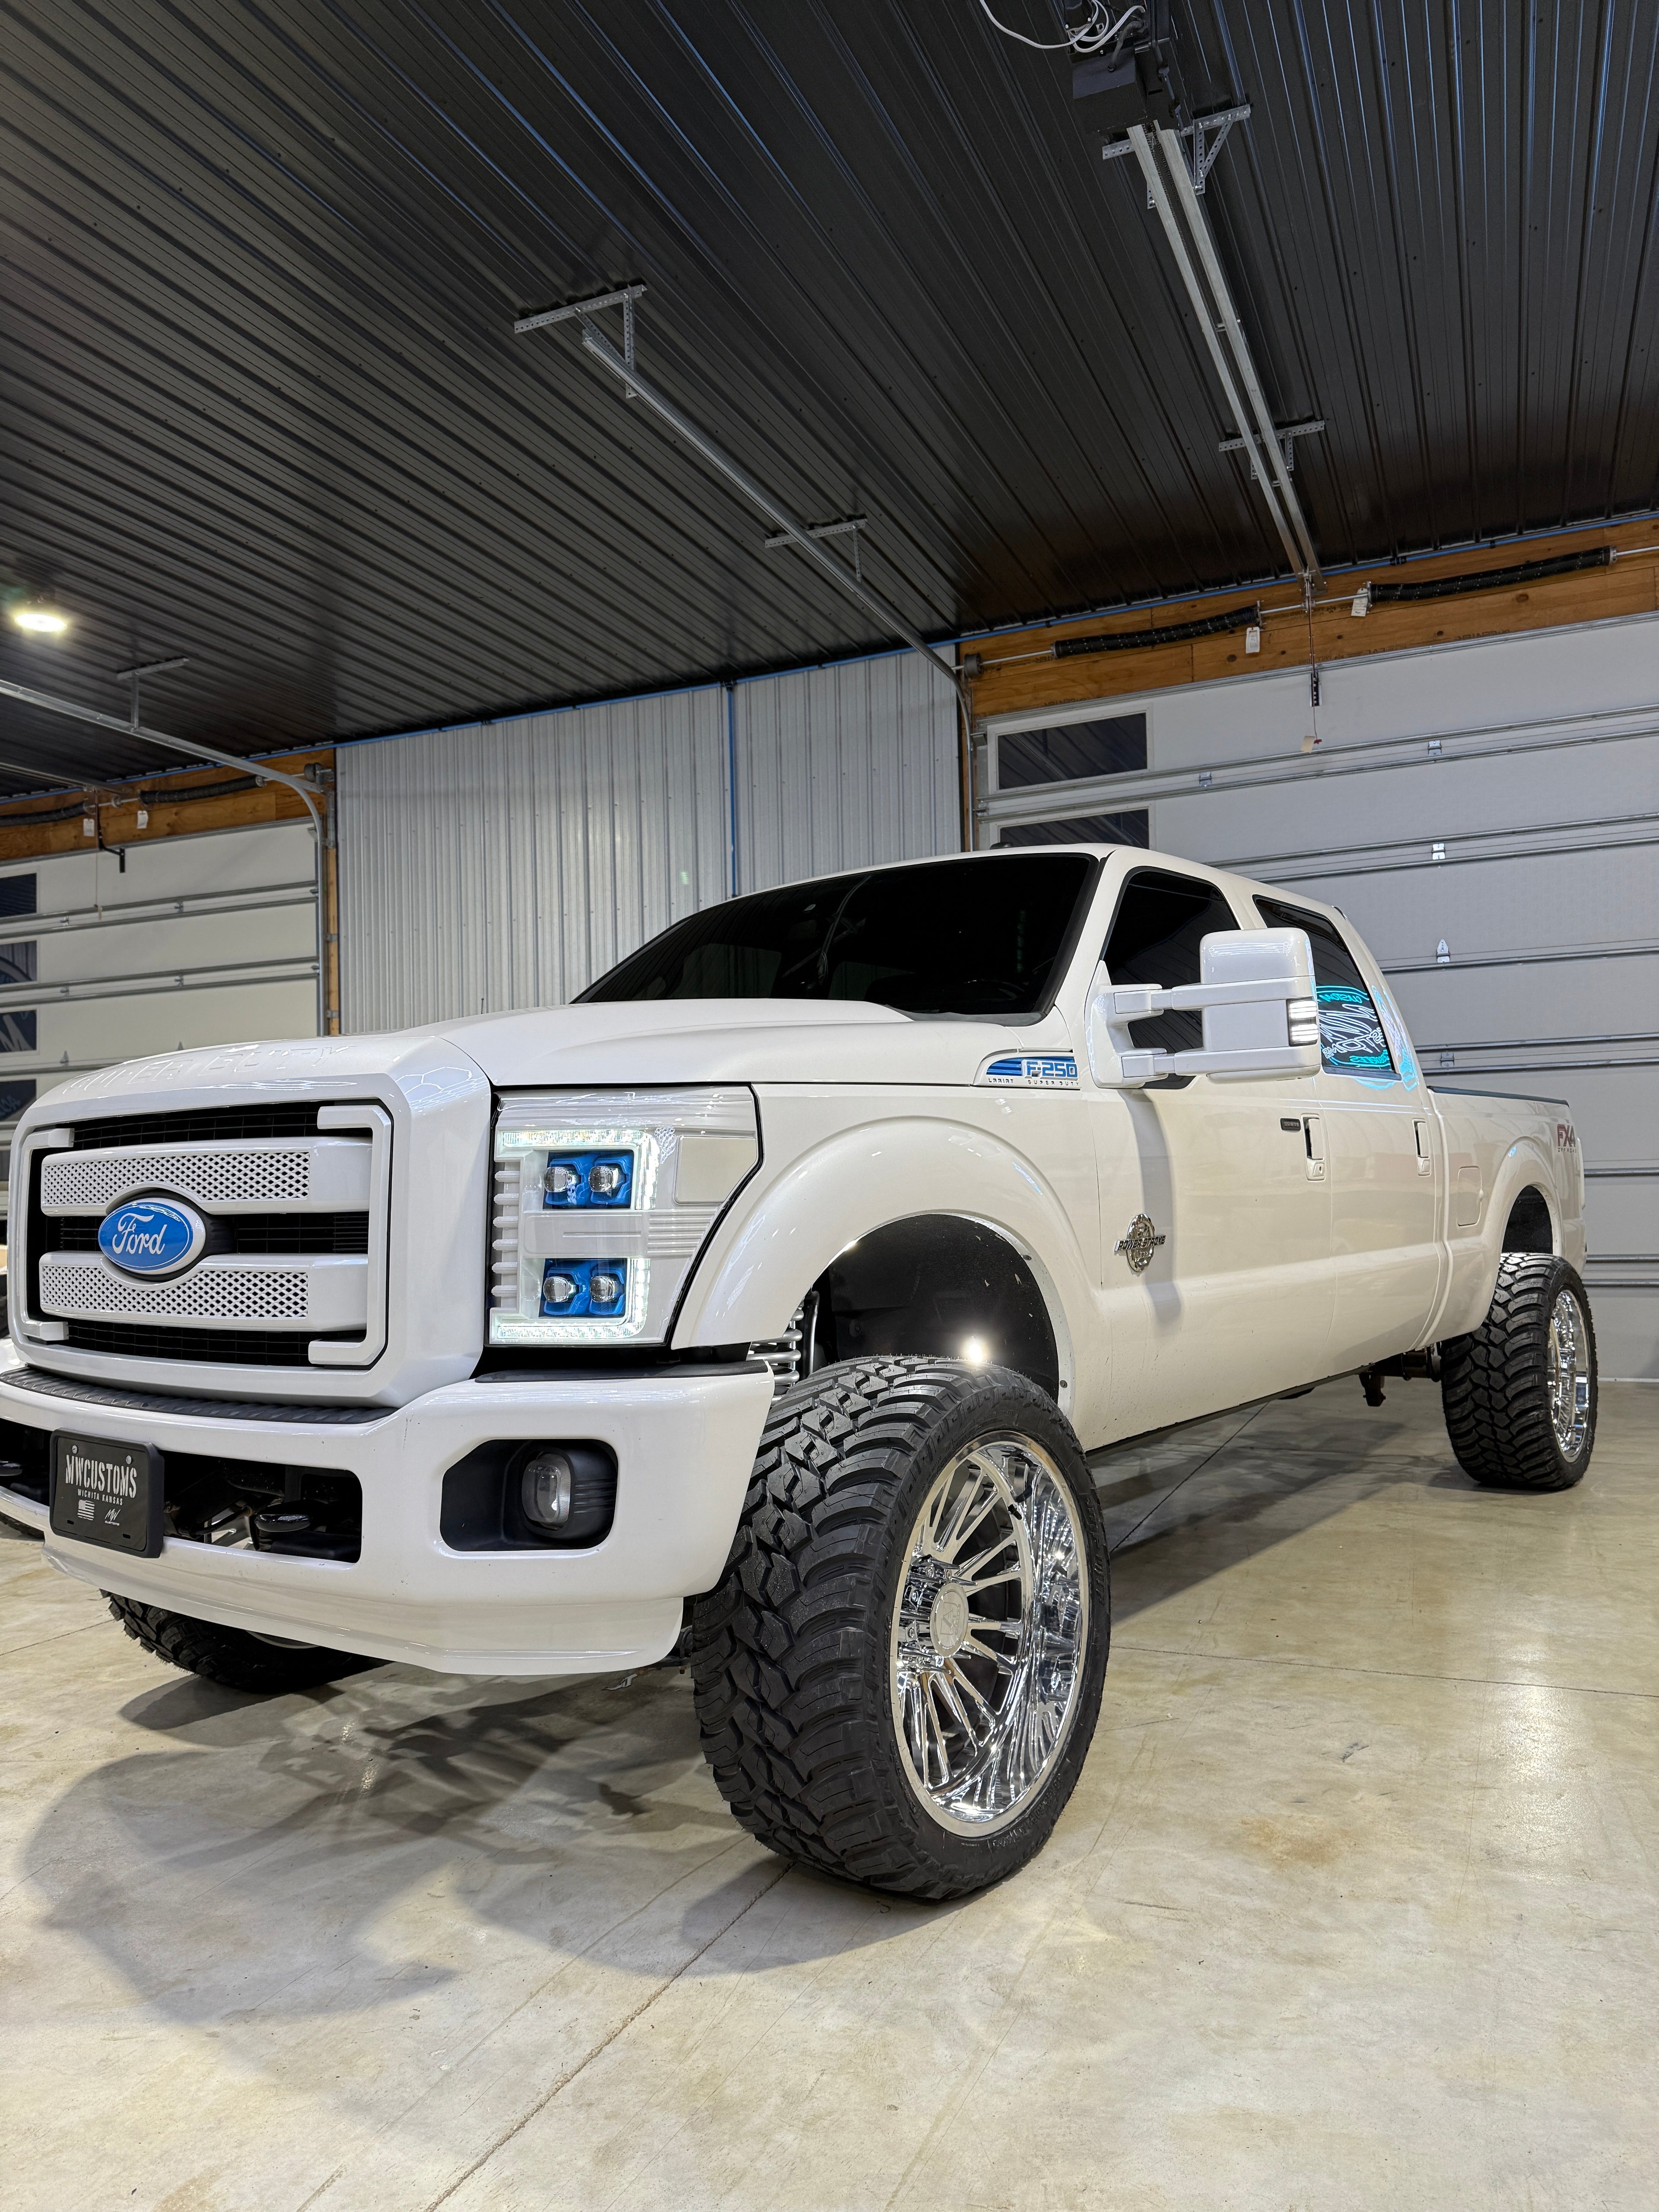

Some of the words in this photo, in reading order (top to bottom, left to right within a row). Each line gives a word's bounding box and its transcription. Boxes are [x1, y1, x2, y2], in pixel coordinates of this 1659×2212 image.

[1024, 1060, 1078, 1081] F-250
[1557, 1124, 1576, 1147] FX4
[112, 1213, 168, 1254] Ford
[78, 1489, 100, 1500] WICHITA
[102, 1494, 123, 1506] KANSAS
